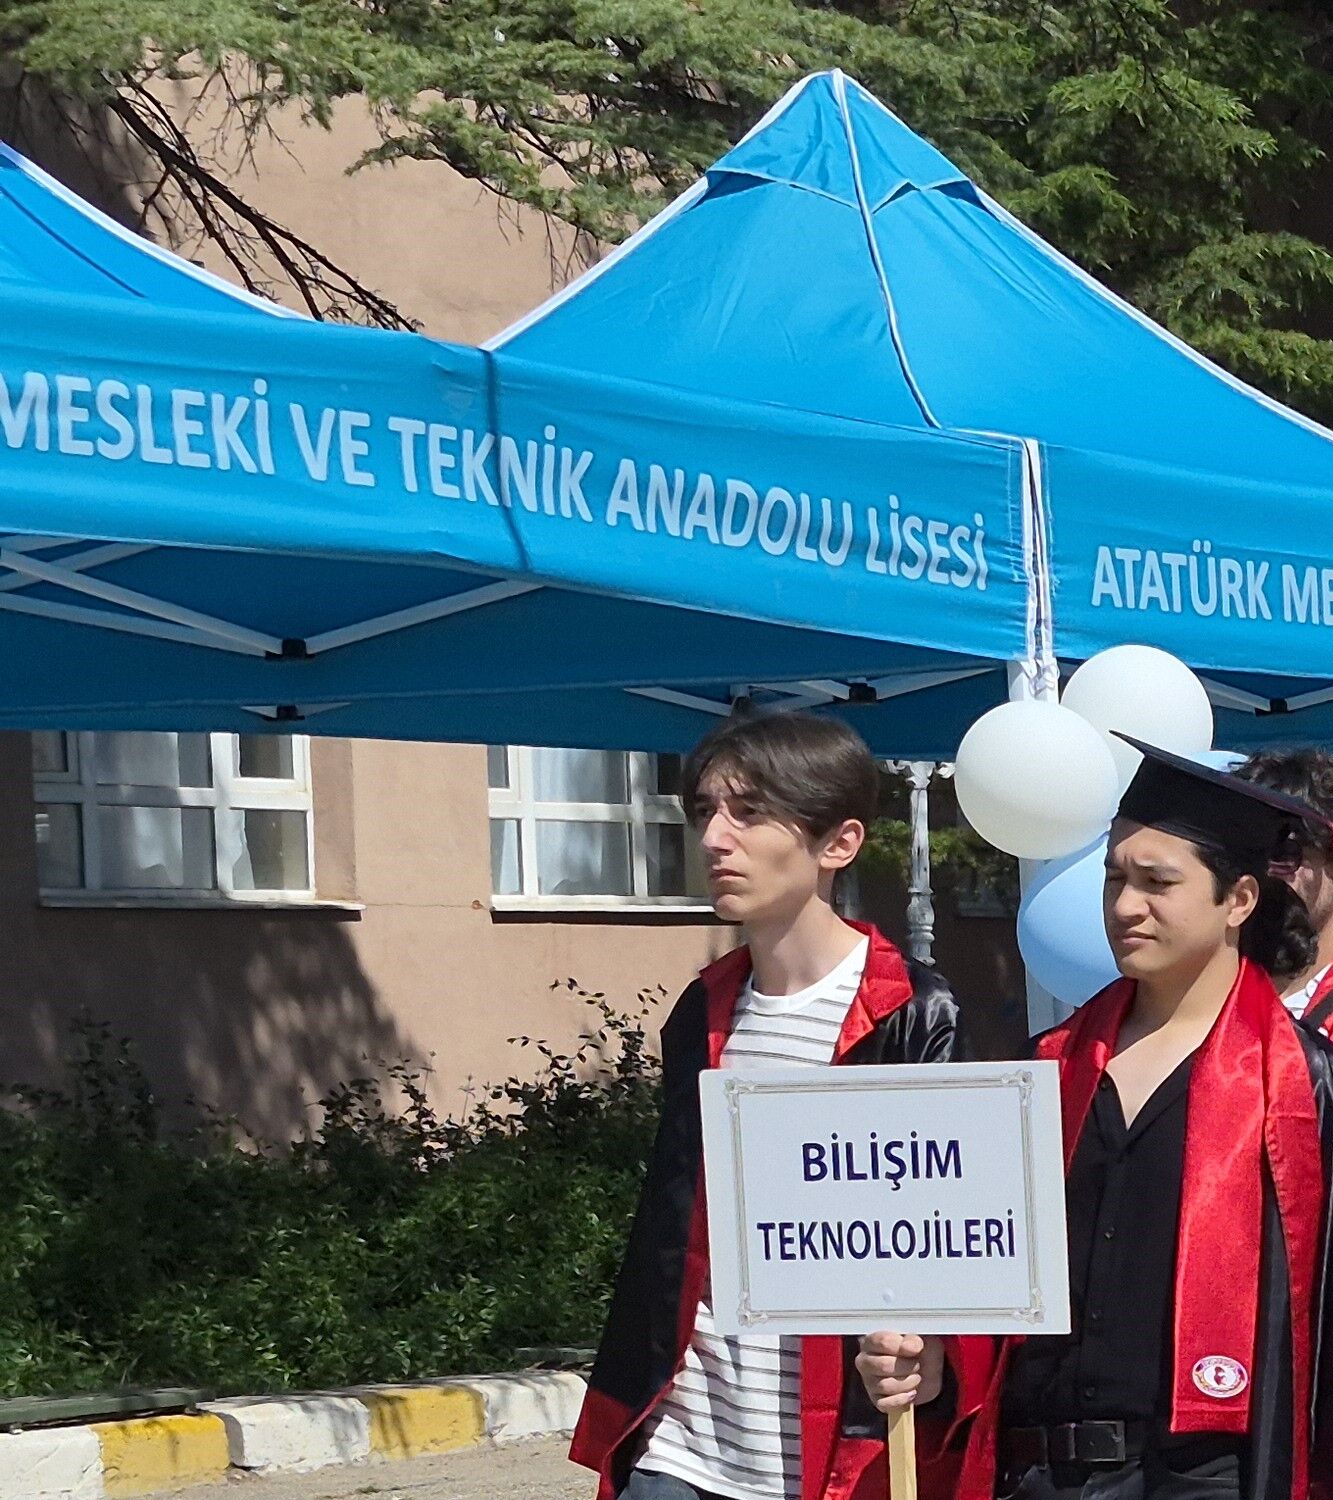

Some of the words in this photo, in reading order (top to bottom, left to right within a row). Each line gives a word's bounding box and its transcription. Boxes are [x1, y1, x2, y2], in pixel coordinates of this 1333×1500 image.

[289, 402, 375, 486] VE
[388, 416, 593, 522] TEKNİK
[605, 458, 854, 567] ANADOLU
[866, 495, 989, 590] LİSESİ
[1091, 540, 1274, 622] ATATÜRK
[801, 1130, 963, 1192] BİLİŞİM
[756, 1208, 1016, 1261] TEKNOLOJİLERİ
